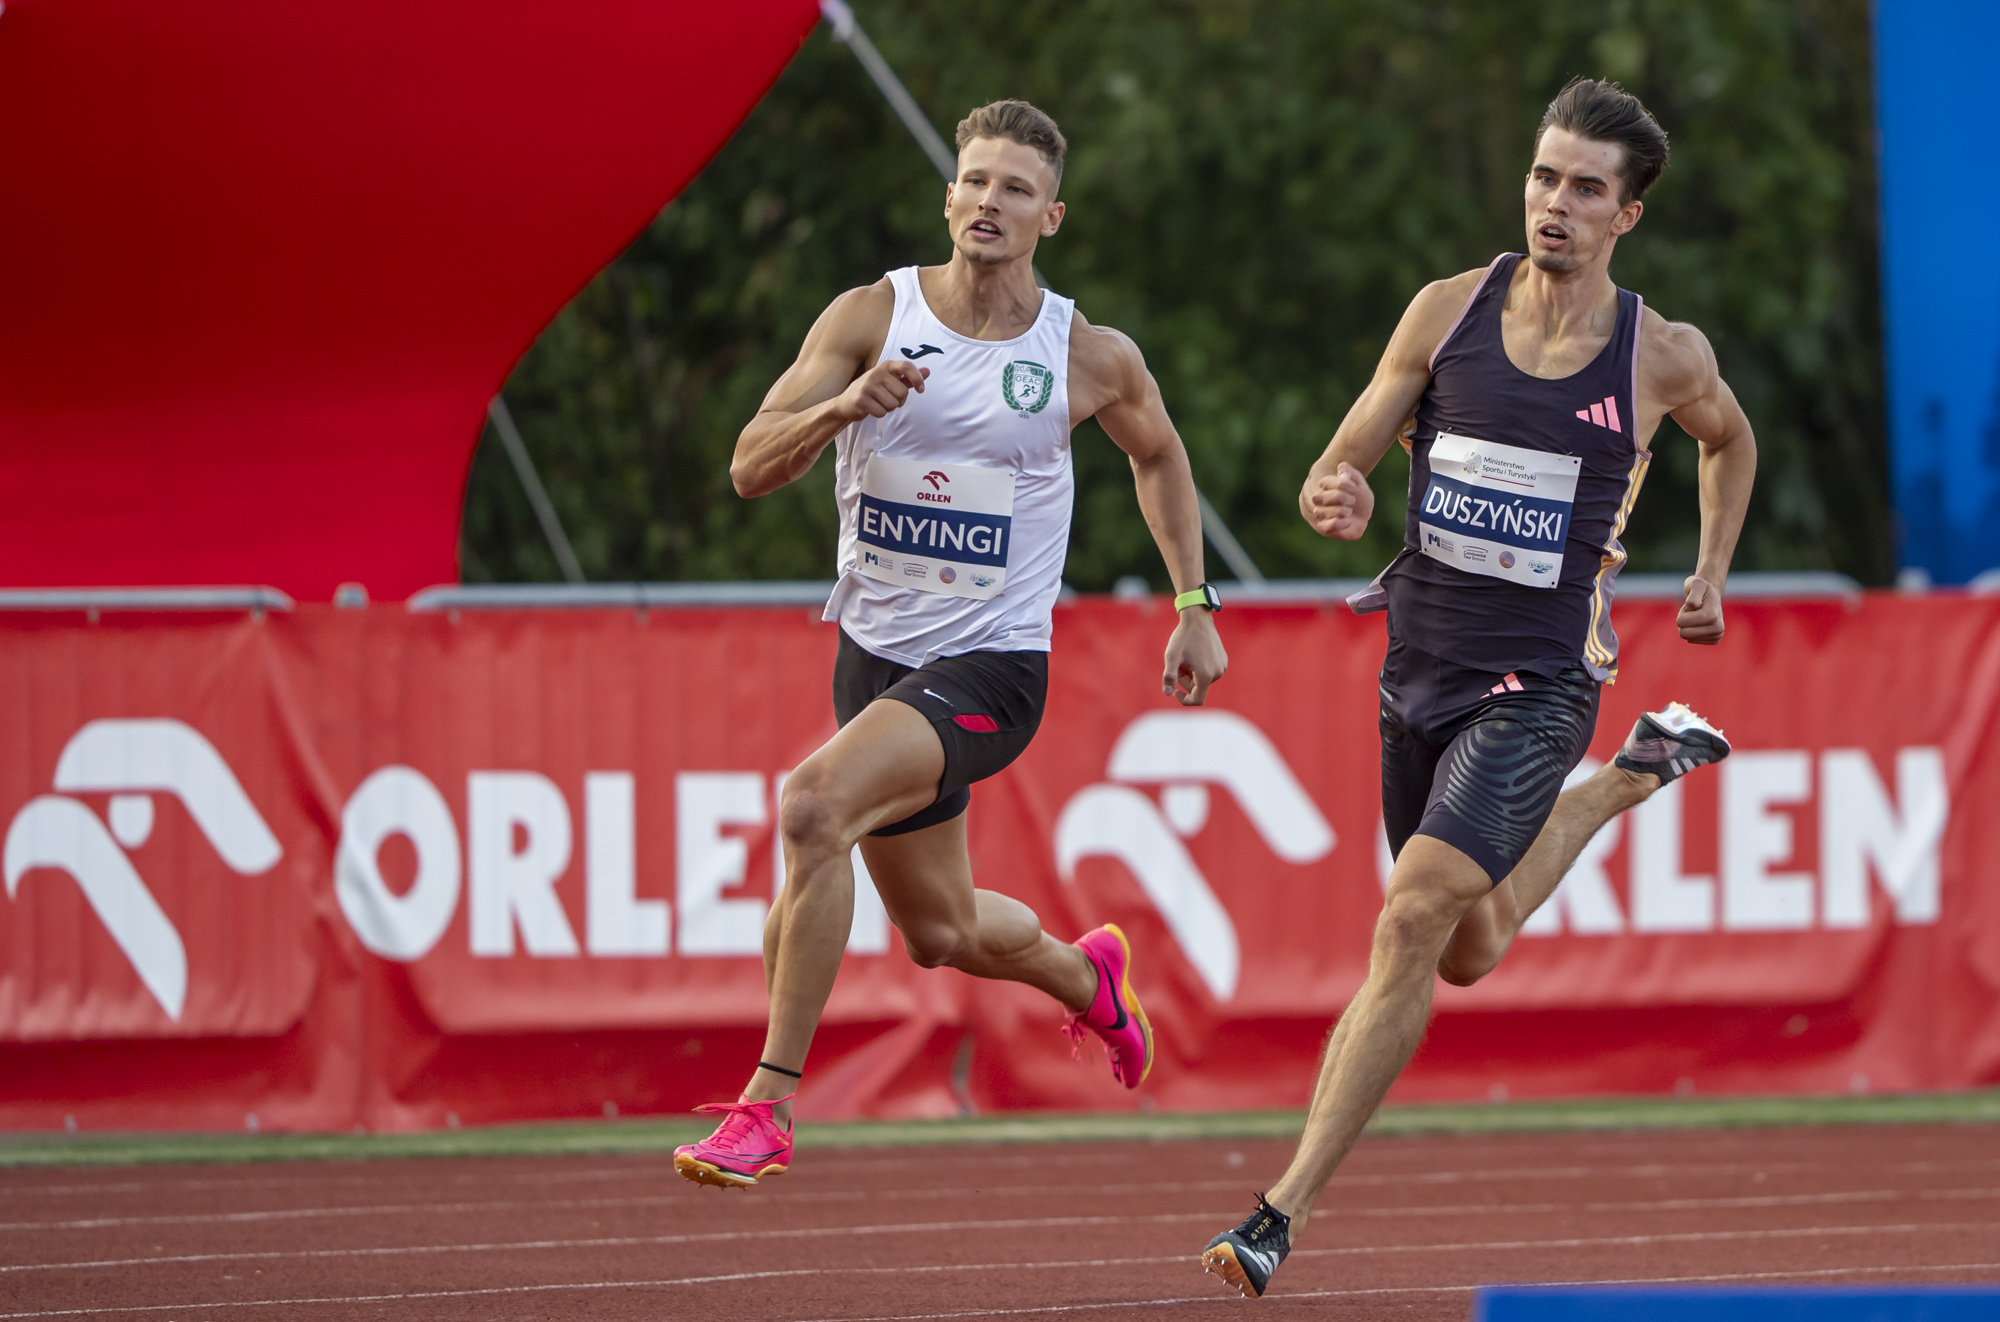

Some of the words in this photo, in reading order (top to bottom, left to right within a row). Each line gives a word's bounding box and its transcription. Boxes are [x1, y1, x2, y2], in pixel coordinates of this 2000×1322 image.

[1015, 375, 1041, 385] GEAC
[1483, 456, 1525, 471] Ministerstwo
[1482, 464, 1504, 475] Sportu
[1507, 469, 1537, 481] Turystyki
[916, 491, 952, 504] ORLEN
[1425, 485, 1563, 542] DUSZYŃSKI
[863, 506, 1003, 556] ENYINGI
[1376, 747, 1949, 936] RLEN
